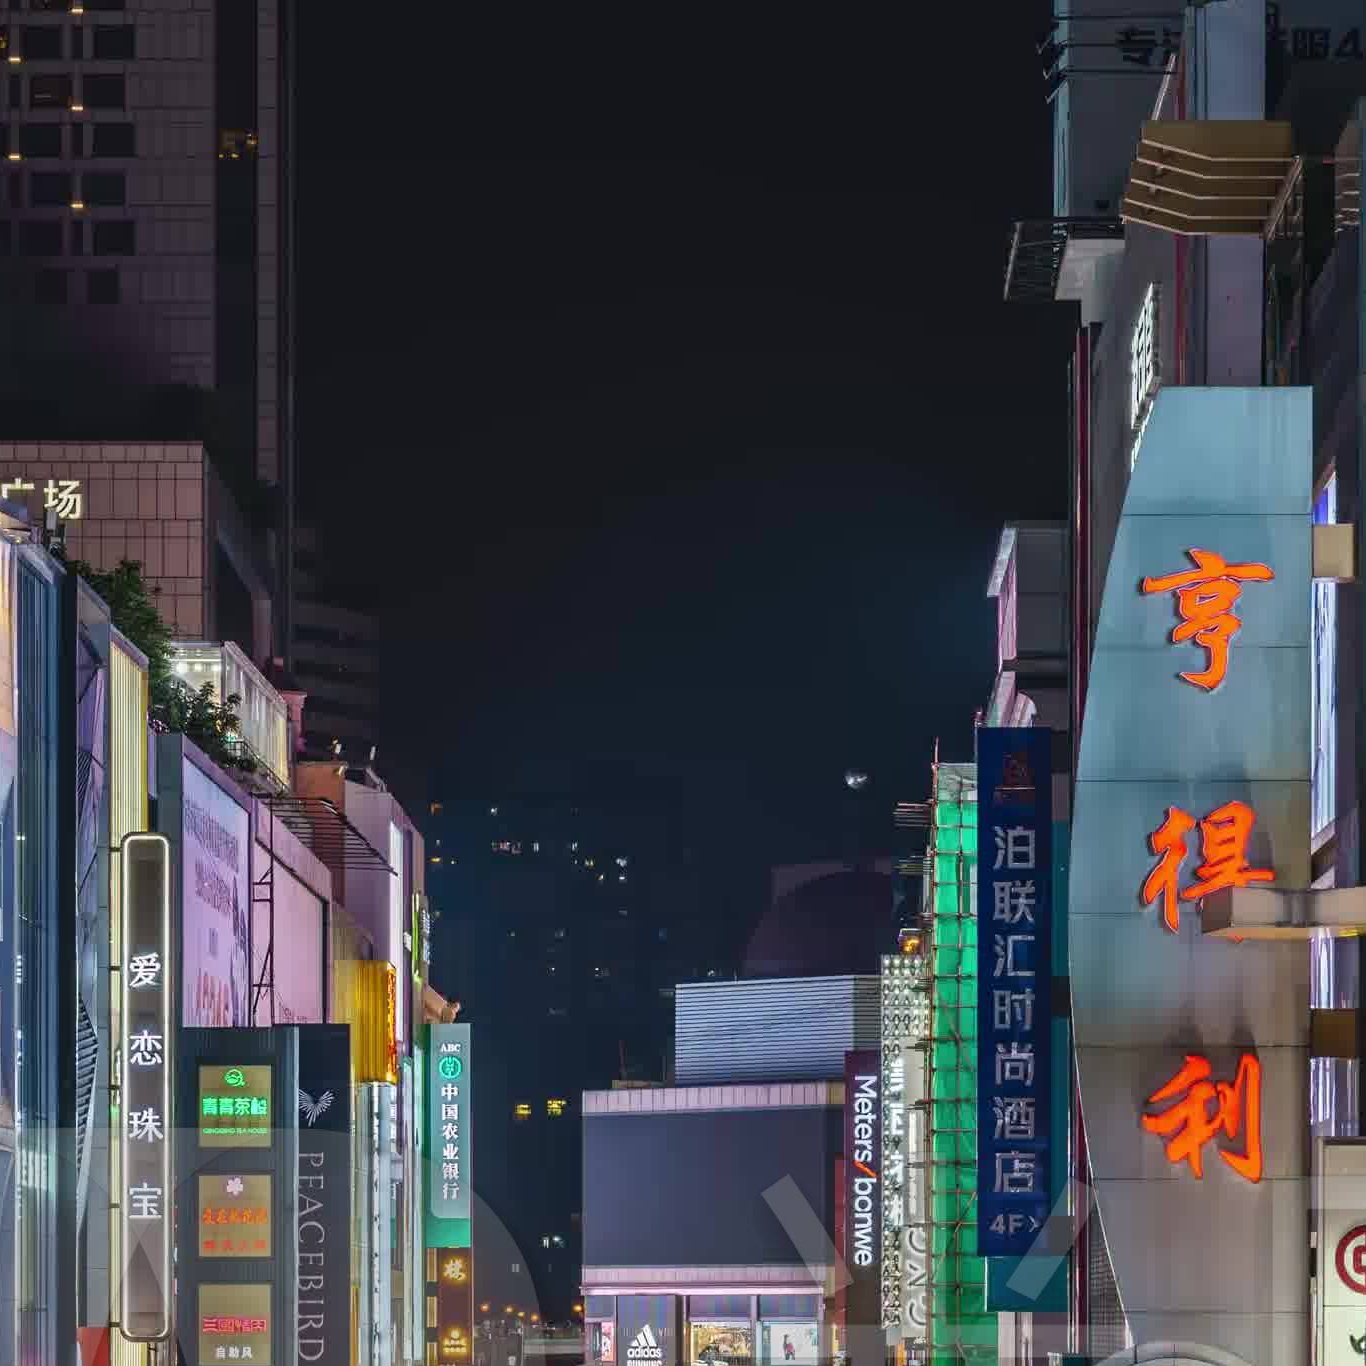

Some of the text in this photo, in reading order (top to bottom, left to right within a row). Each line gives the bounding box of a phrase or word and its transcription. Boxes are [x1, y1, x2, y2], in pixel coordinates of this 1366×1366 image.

[1141, 548, 1276, 1186] 亨得利
[129, 952, 164, 1221] 爱恋珠宝
[440, 1043, 461, 1052] ABC
[992, 825, 1036, 1194] 泊联汇时尚酒店
[441, 1083, 460, 1200] 中国农业银行
[298, 1152, 325, 1361] PEACEBIRD
[989, 1214, 1024, 1235] 4F
[627, 1346, 662, 1359] adidas
